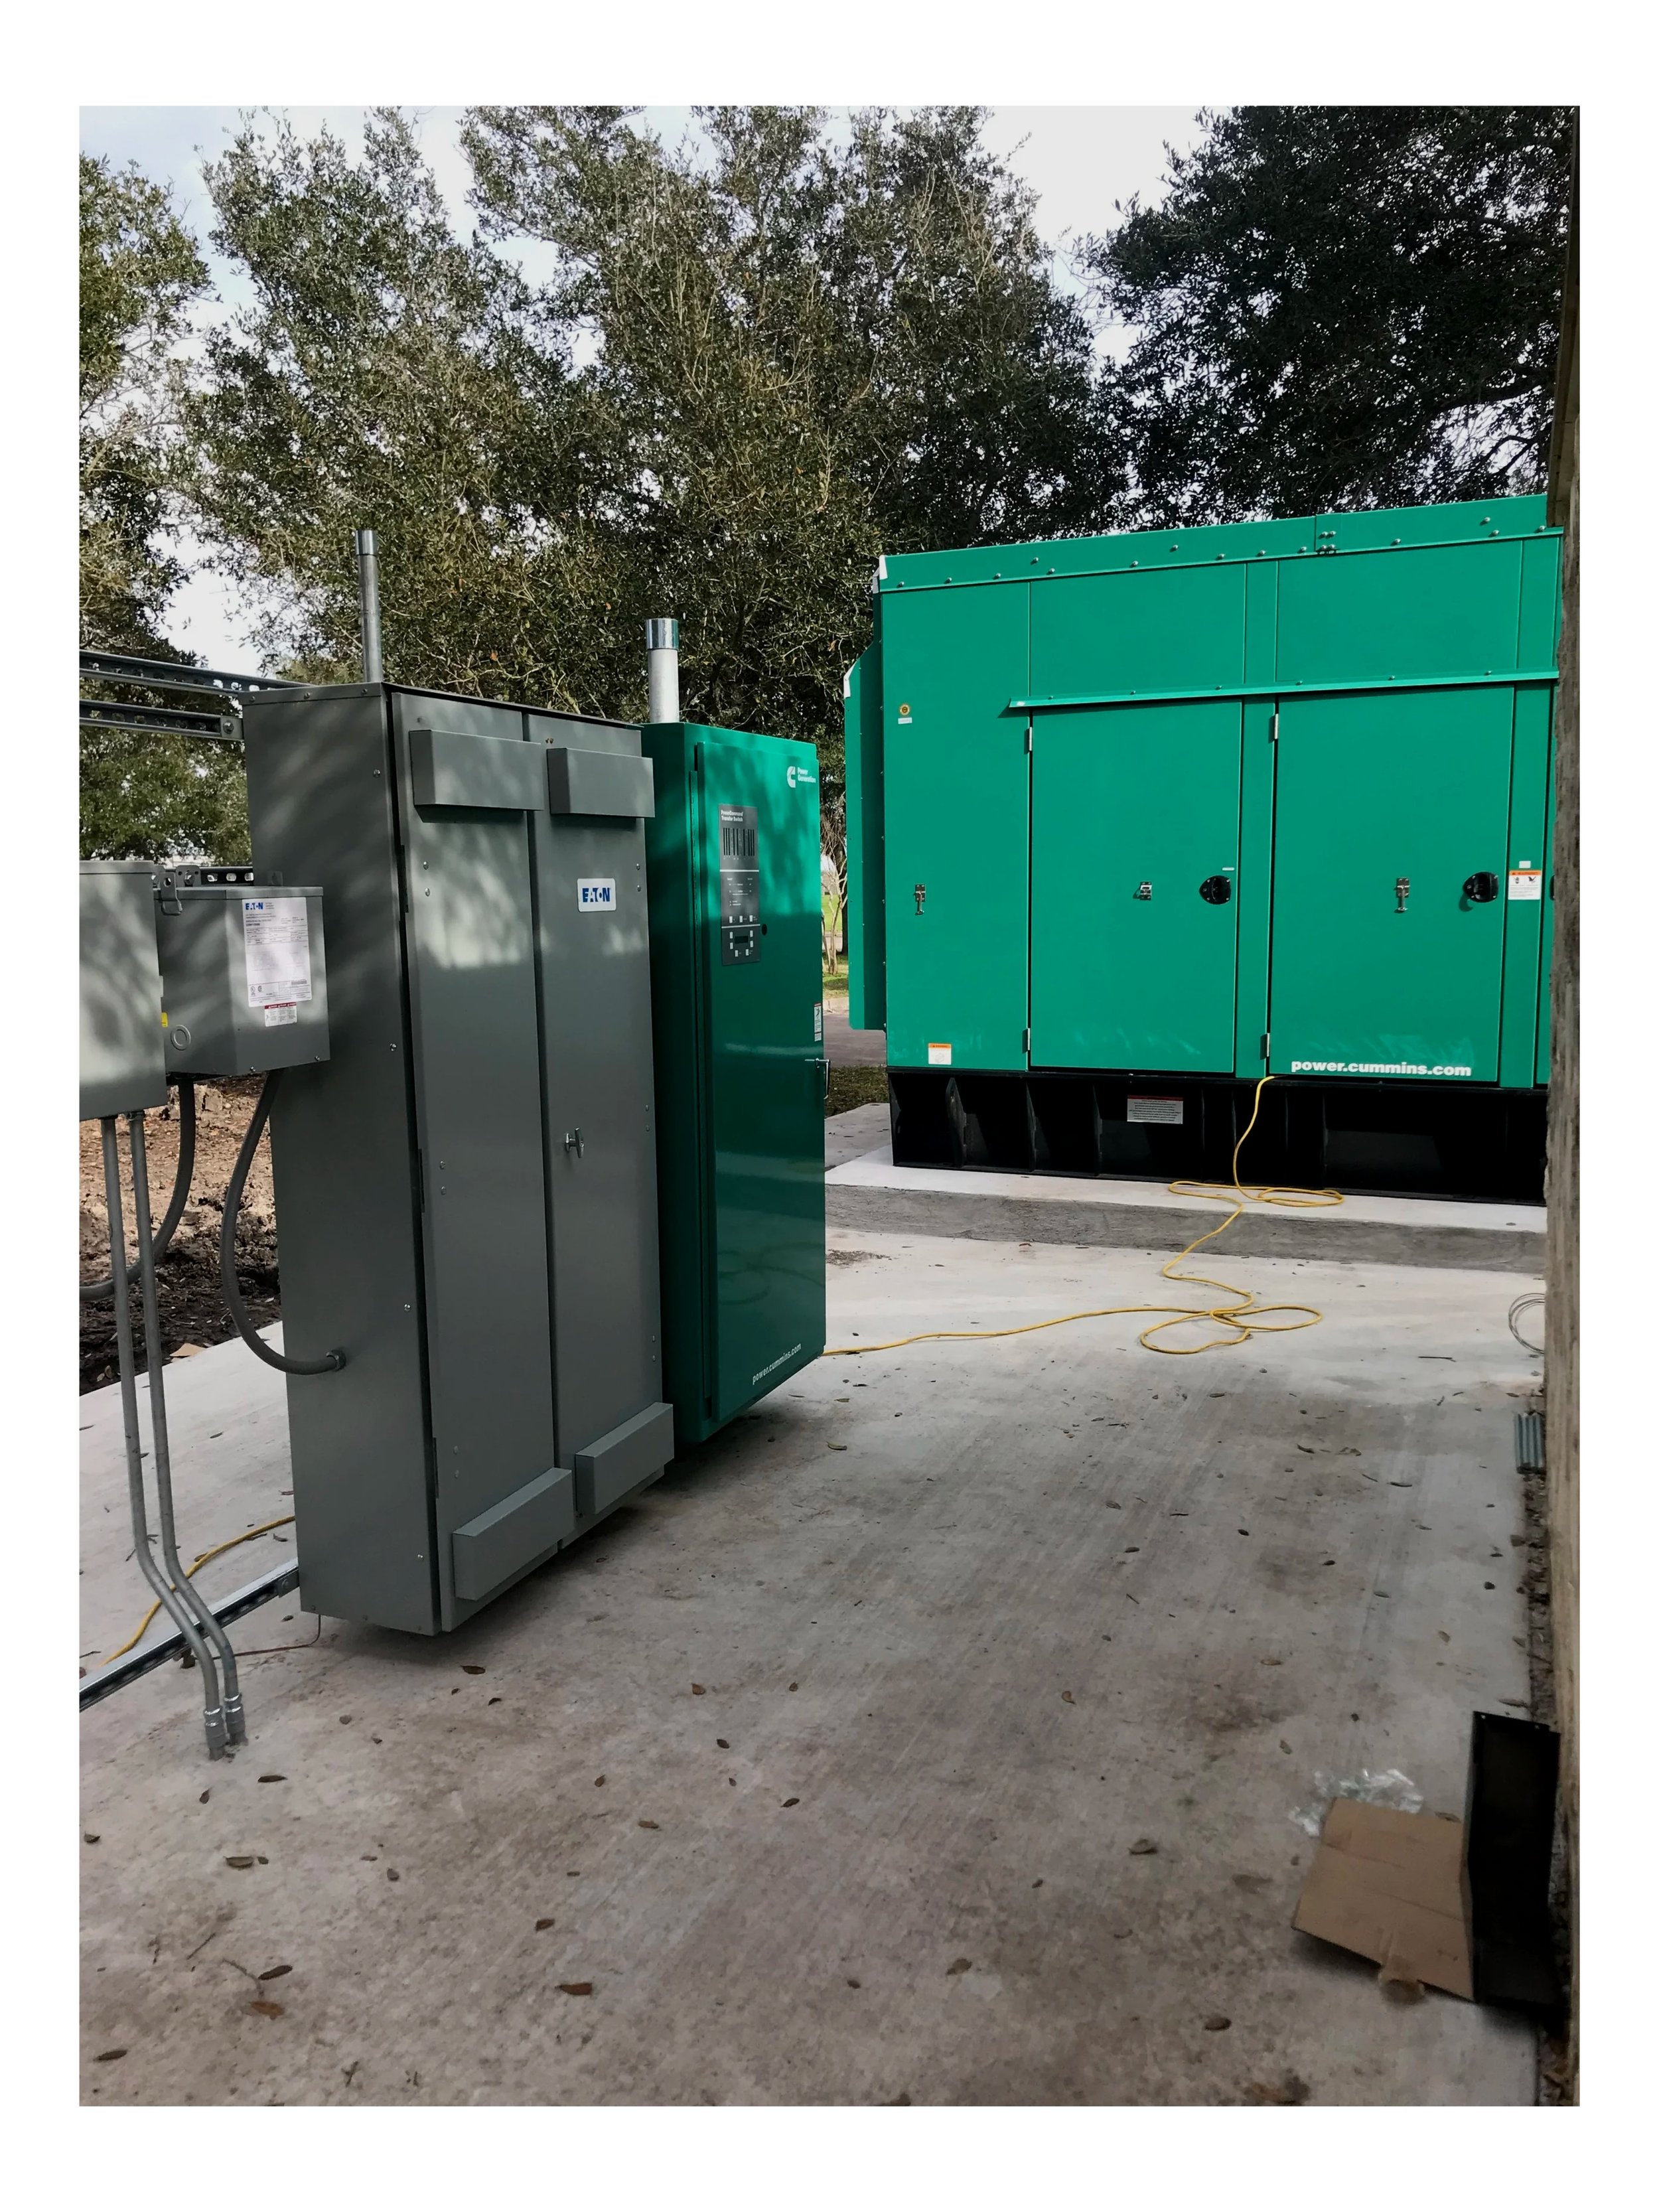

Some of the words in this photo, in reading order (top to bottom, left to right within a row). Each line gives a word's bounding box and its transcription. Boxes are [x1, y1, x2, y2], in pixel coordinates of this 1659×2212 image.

[582, 887, 611, 903] EATON
[1291, 1061, 1471, 1076] power.cummins.com
[753, 1343, 801, 1385] power.cummins.com
